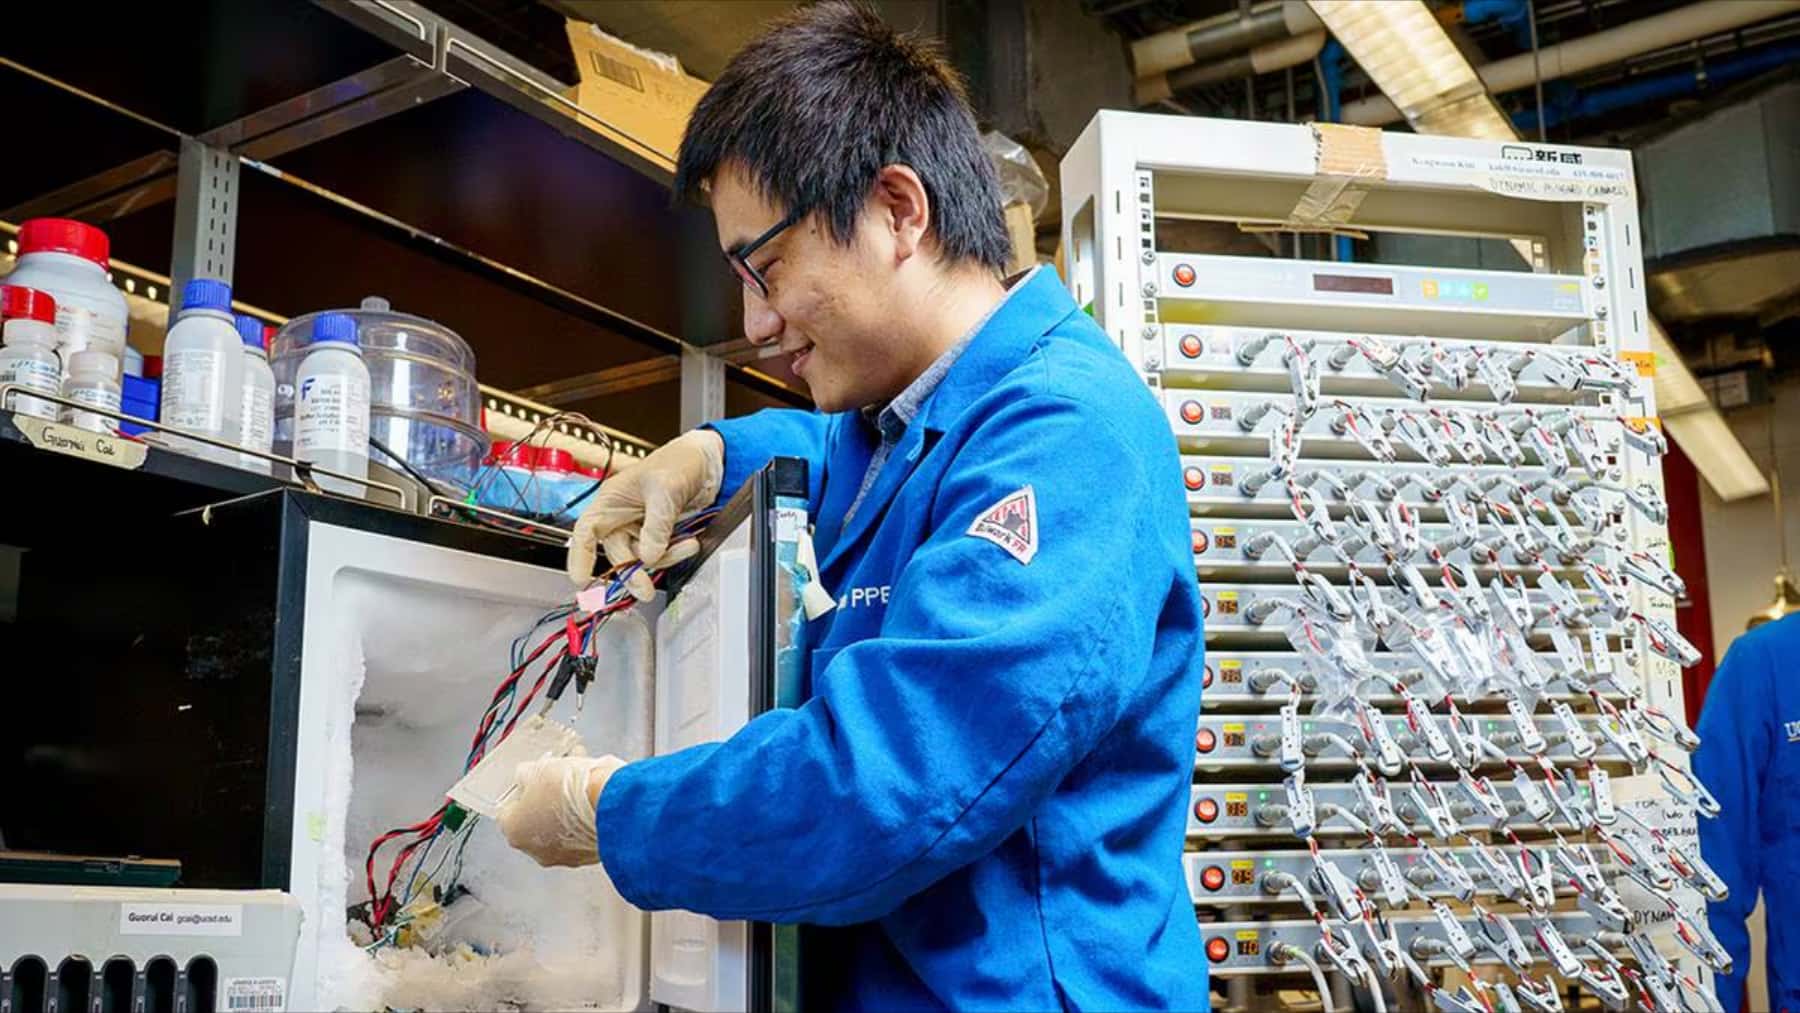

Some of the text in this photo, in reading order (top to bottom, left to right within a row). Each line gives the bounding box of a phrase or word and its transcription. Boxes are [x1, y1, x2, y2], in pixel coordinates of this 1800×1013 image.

[851, 586, 890, 608] PPE
[128, 912, 158, 922] Guorui
[160, 912, 174, 922] Cai
